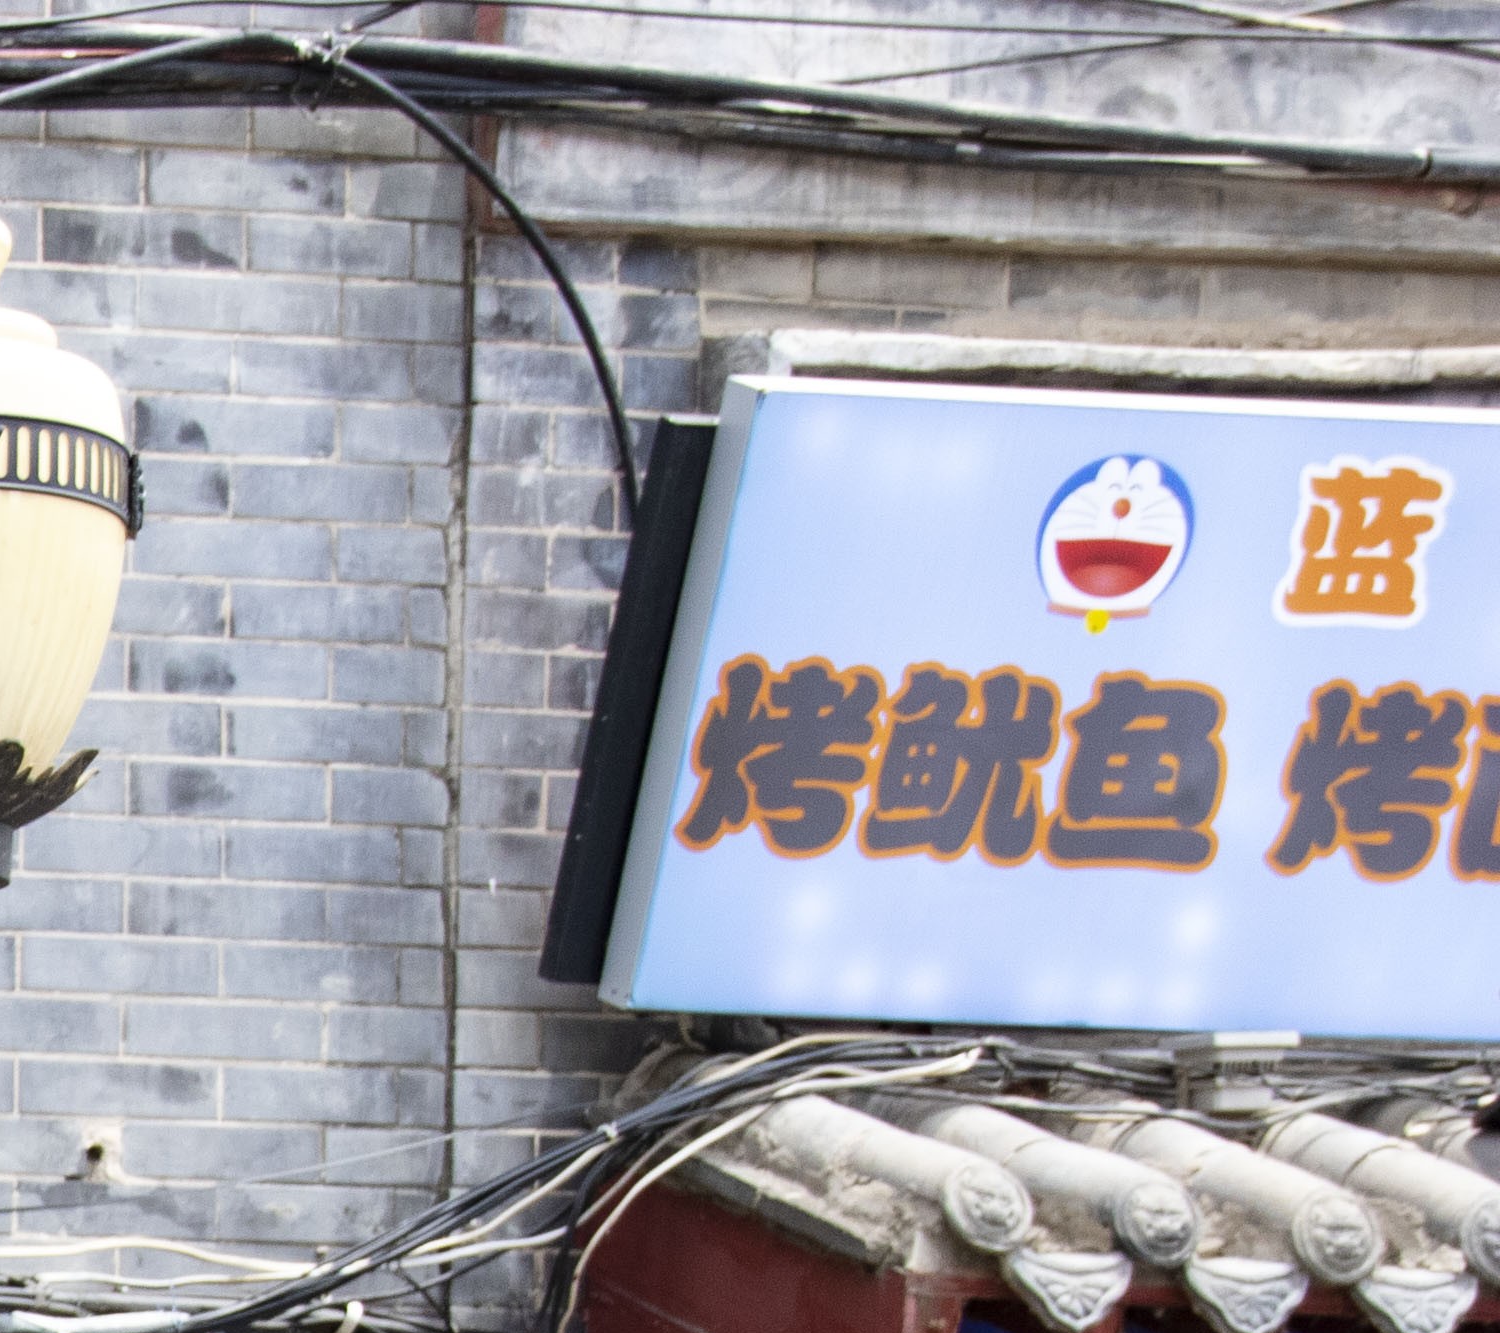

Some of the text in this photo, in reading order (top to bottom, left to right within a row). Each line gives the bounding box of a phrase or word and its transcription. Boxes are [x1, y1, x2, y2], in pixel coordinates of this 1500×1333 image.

[1285, 467, 1444, 616] 蓝
[673, 653, 1227, 875] 烤鱿鱼
